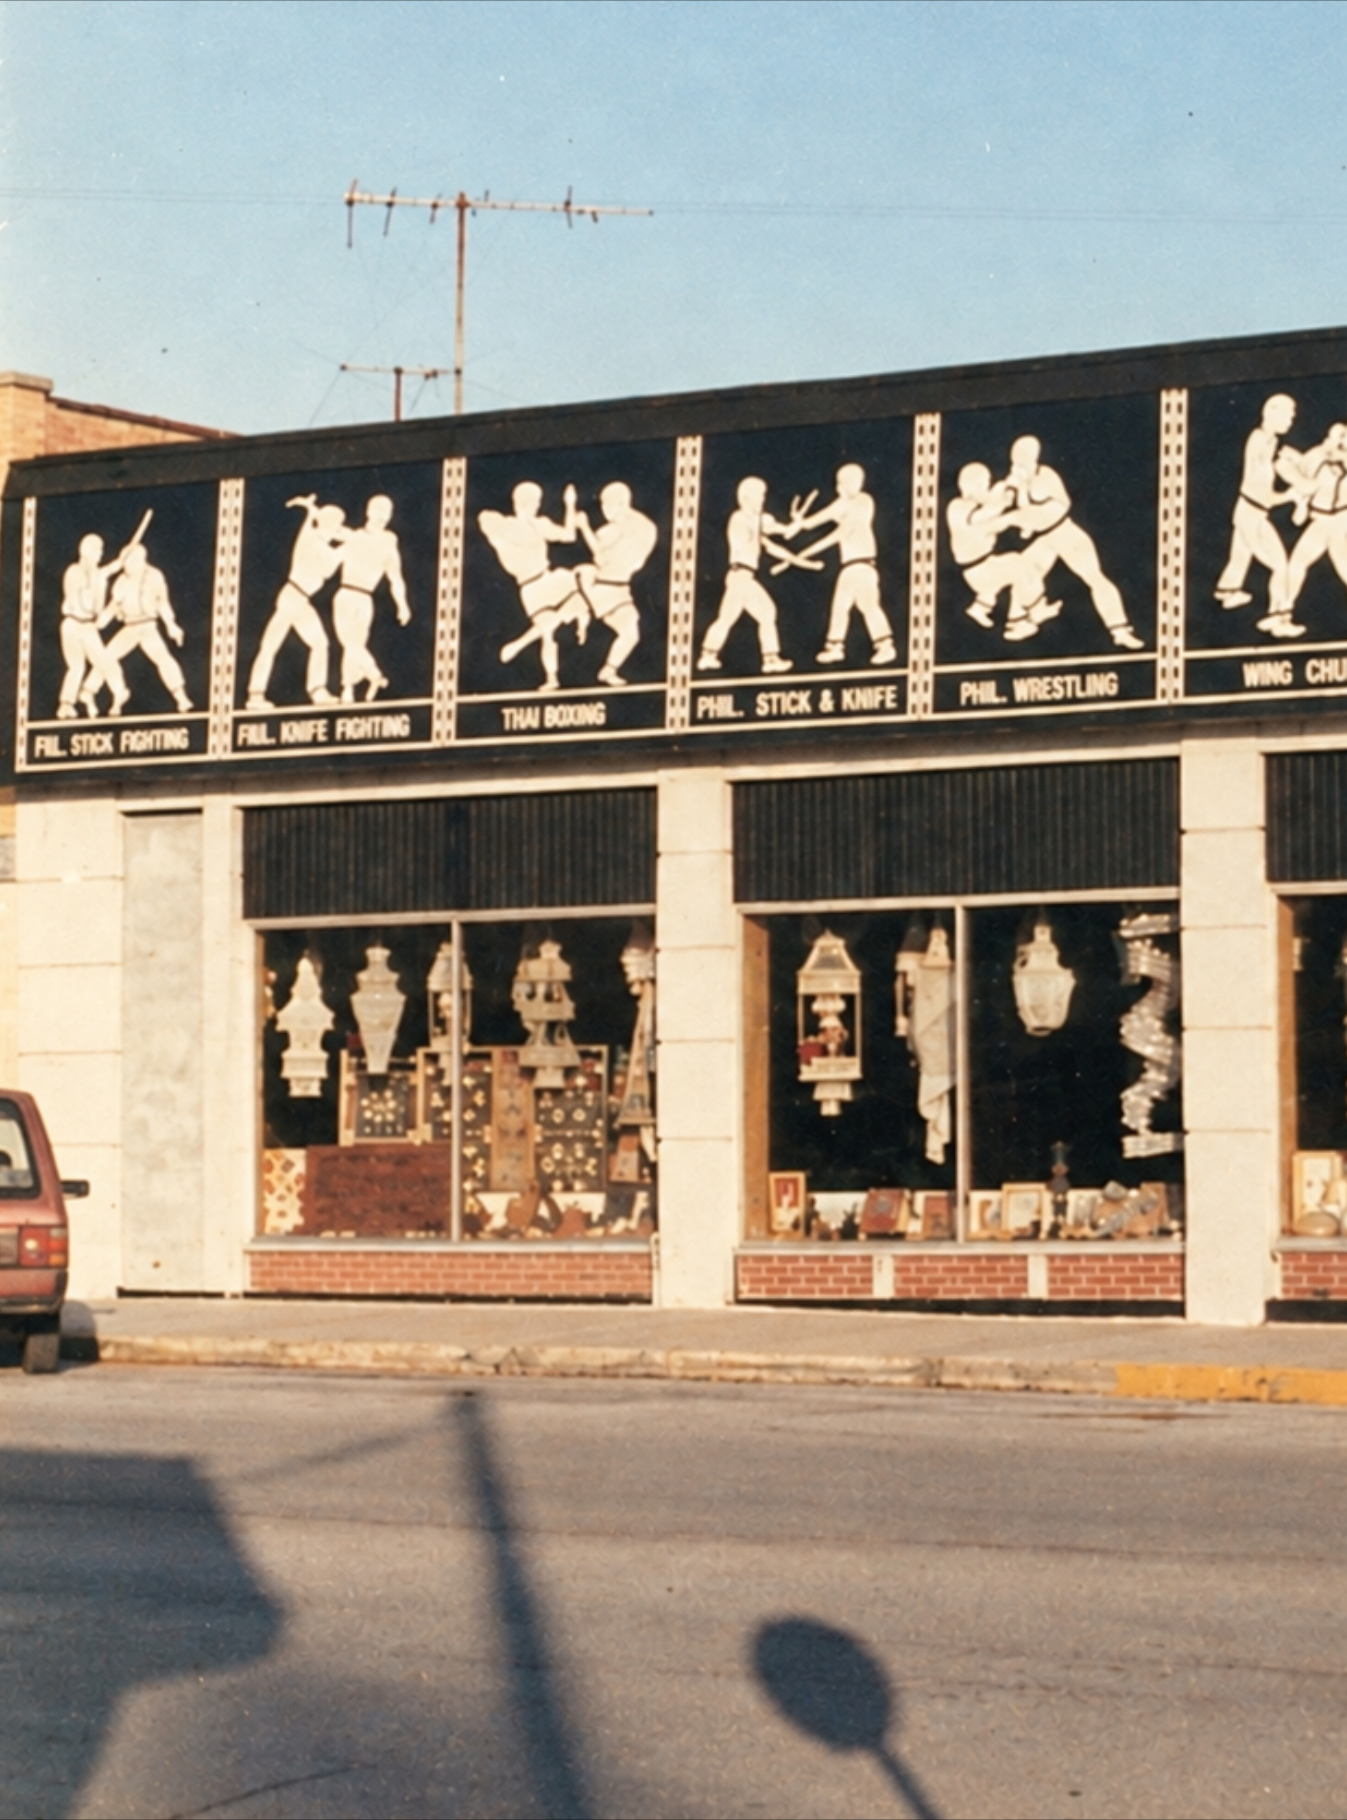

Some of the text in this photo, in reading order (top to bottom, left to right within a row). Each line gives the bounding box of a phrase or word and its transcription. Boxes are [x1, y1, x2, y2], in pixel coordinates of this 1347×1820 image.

[1243, 661, 1292, 687] WING
[697, 686, 897, 718] PHIL. STICK & KNIFE
[961, 672, 1118, 705] PHIL. WRESTLING
[281, 719, 327, 743] KNIFE
[336, 714, 410, 740] FIGHTING
[502, 702, 605, 730] THAI BOXING
[71, 733, 113, 755] STICK
[120, 728, 189, 753] FIGHTING
